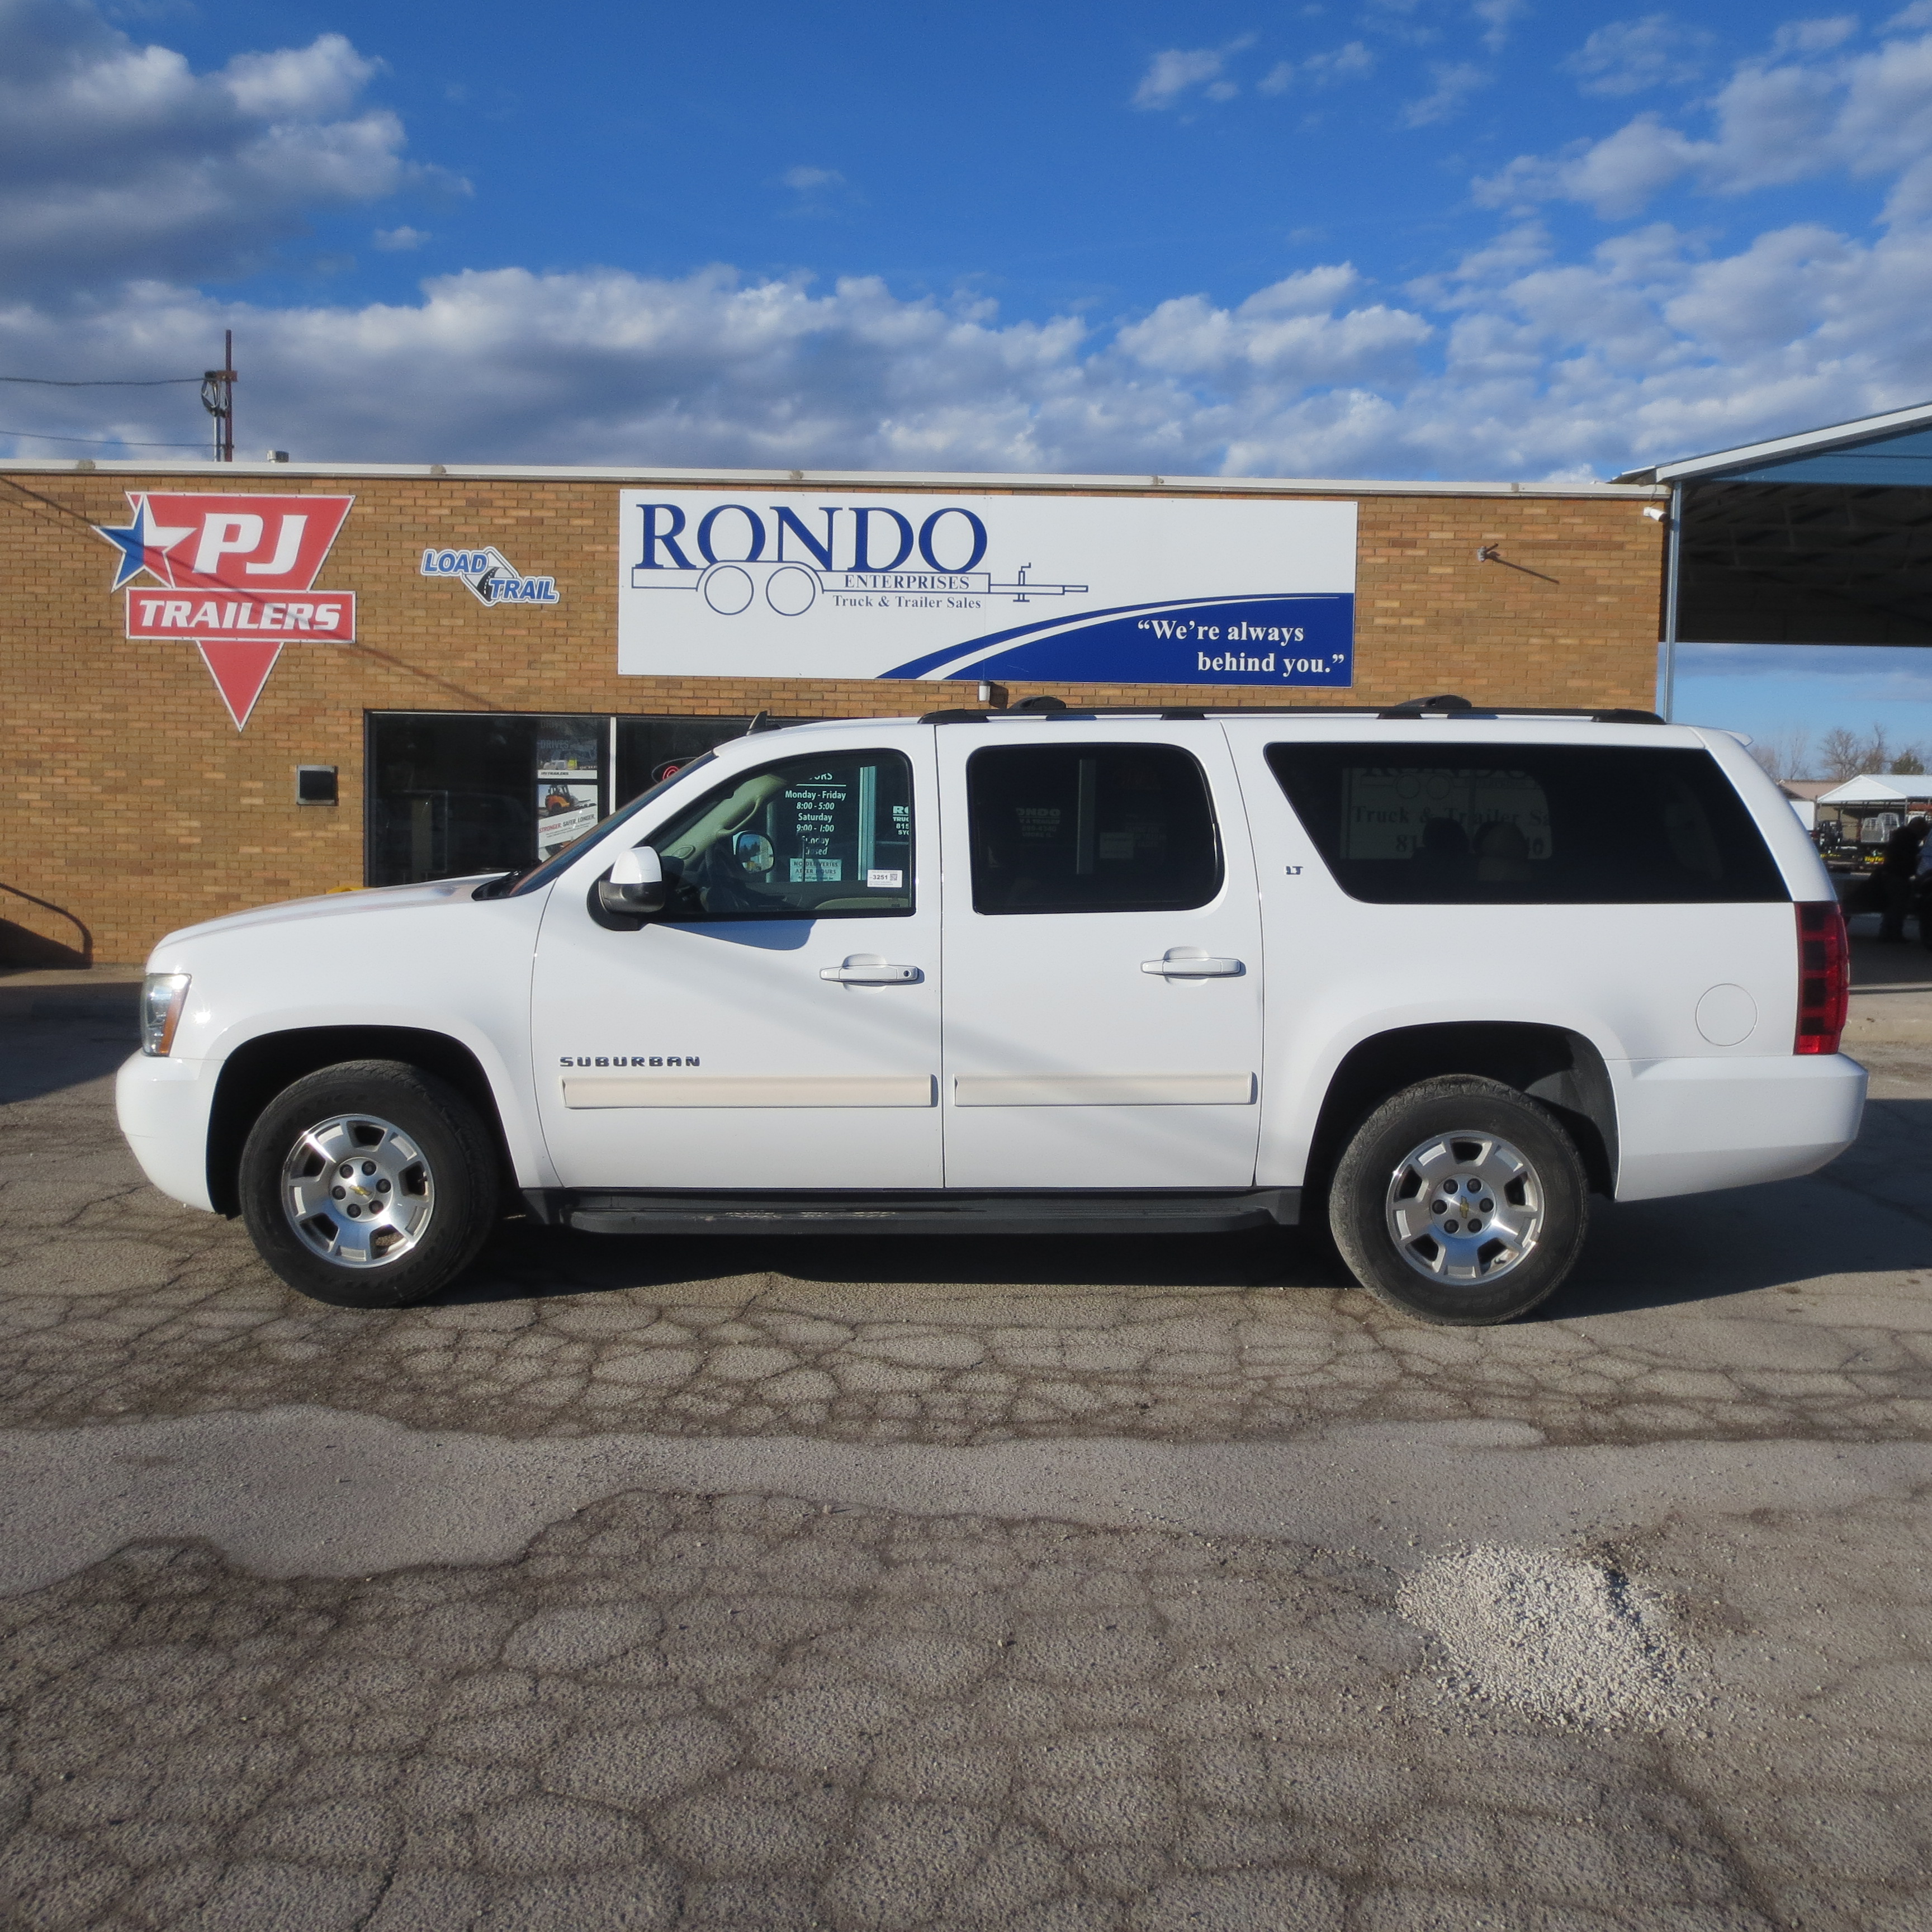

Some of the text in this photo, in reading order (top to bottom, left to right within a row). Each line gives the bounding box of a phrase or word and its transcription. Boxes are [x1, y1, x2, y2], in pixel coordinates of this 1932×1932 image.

[192, 513, 309, 574] PJ
[635, 504, 988, 573] RONDO
[424, 553, 487, 573] LOAD
[490, 580, 556, 600] TRAIL
[844, 574, 970, 590] ENTERPRISES
[832, 595, 982, 609] Truck & Trailer Sales
[139, 599, 342, 630] TRAILERS
[1138, 619, 1304, 646] “We’re always
[1197, 651, 1344, 677] behind you.”
[785, 790, 816, 801] Monday
[822, 790, 846, 801] Friday
[818, 802, 835, 810] 5:00
[798, 812, 832, 823] Saturday
[820, 824, 835, 832] 1:00
[1286, 865, 1304, 875] LT
[560, 1056, 700, 1067] SUBURBAN
